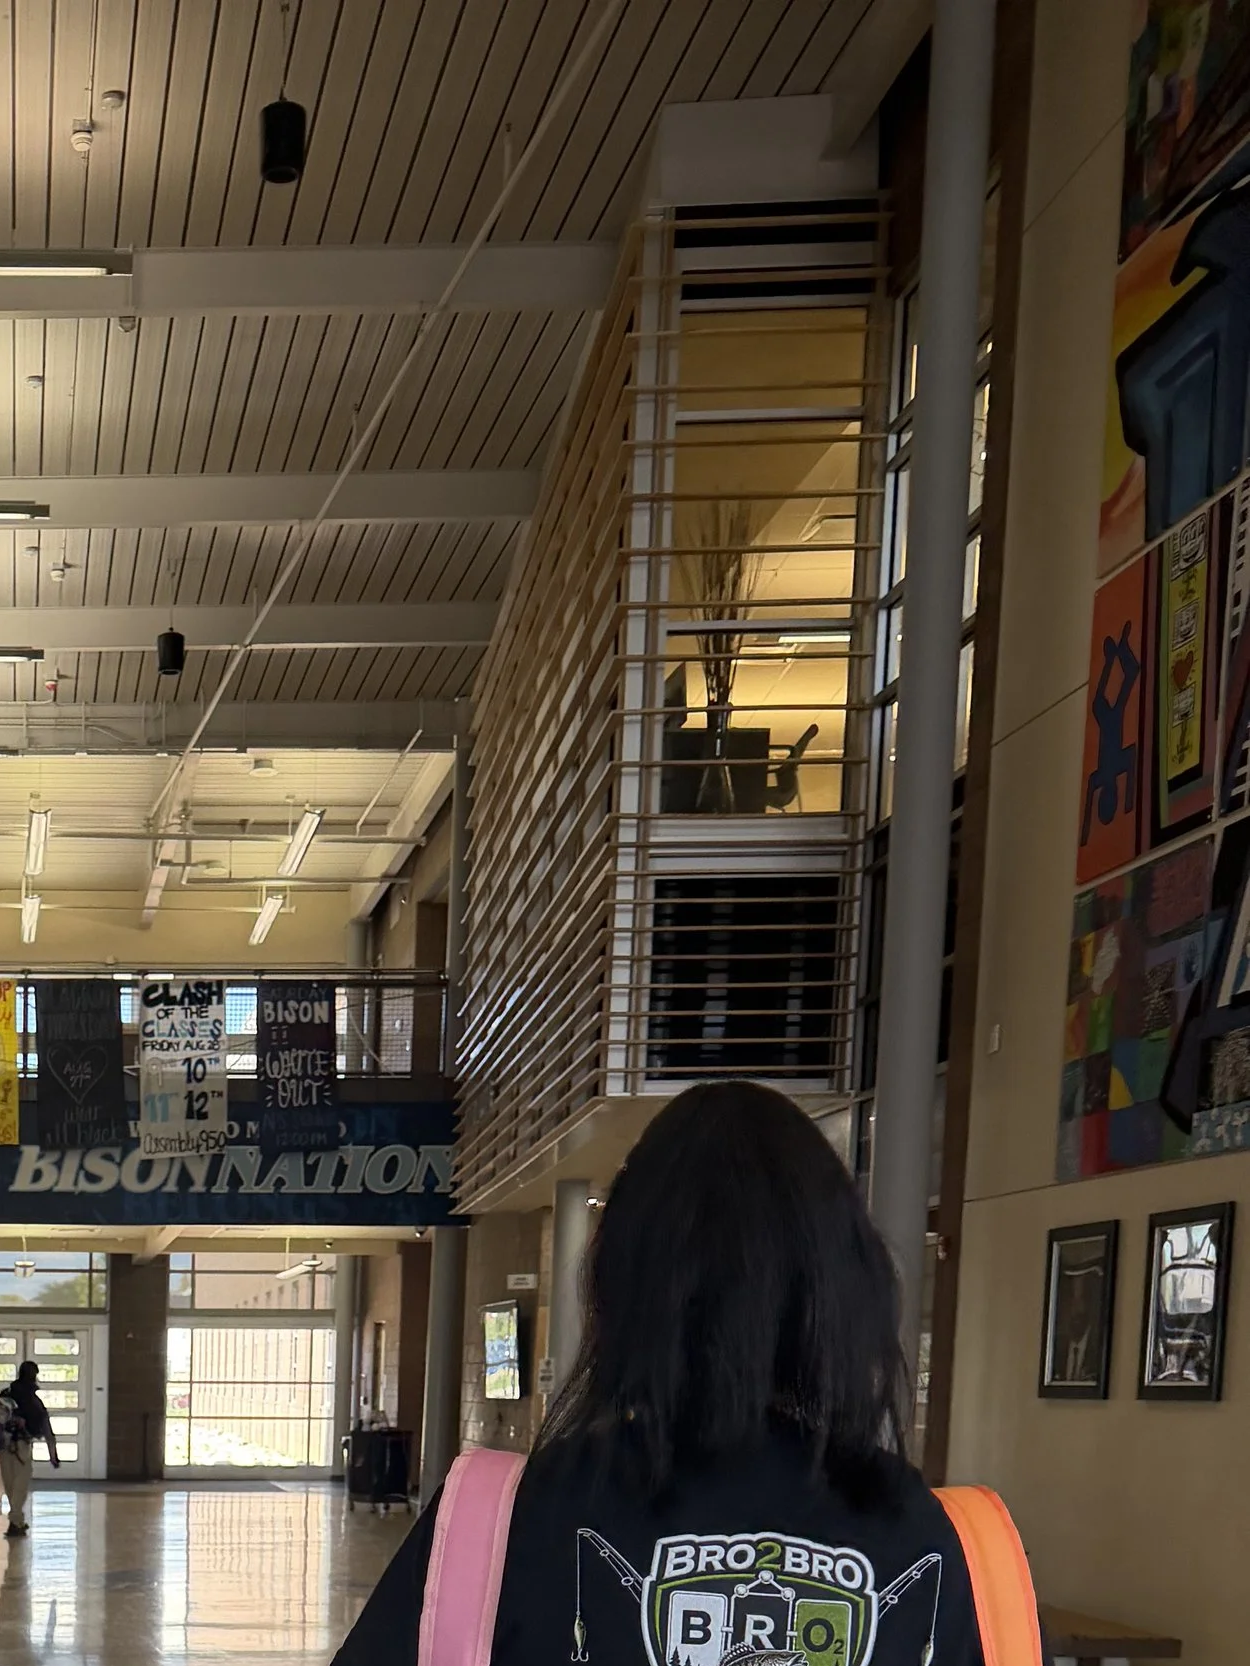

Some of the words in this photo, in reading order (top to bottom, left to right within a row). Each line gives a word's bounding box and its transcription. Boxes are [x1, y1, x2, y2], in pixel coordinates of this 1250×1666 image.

[141, 981, 224, 1008] CLASH
[156, 1008, 175, 1020] OF
[181, 1007, 209, 1019] THE
[261, 1000, 330, 1024] BISON
[142, 1019, 223, 1039] CLASSES
[142, 1040, 181, 1052] FRIDAY
[277, 1078, 325, 1108] OUT
[665, 1540, 864, 1590] BRO2BRO
[680, 1609, 713, 1645] B
[744, 1613, 777, 1650] R
